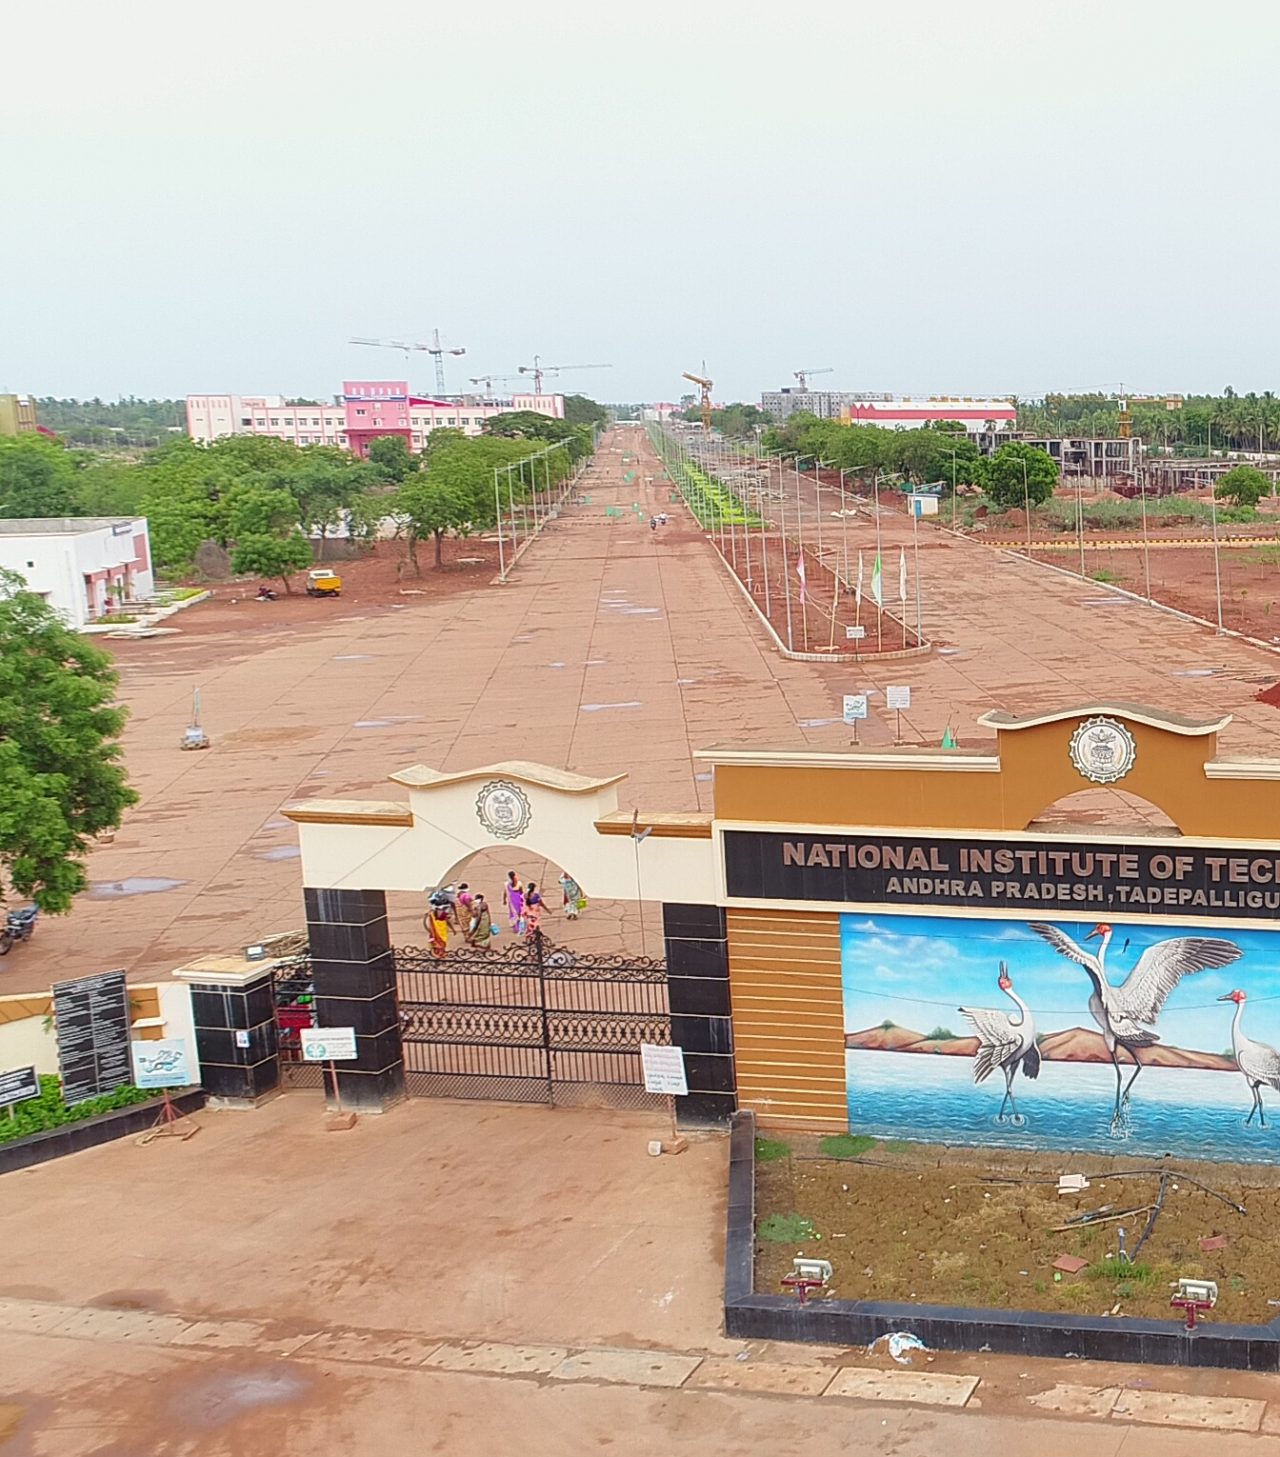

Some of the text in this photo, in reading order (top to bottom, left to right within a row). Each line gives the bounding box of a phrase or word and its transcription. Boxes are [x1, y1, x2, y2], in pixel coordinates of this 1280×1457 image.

[783, 842, 949, 871] NATIONAL
[960, 849, 1139, 879] INSTITUTE
[1150, 855, 1194, 880] OF
[886, 877, 984, 897] ANDHRA
